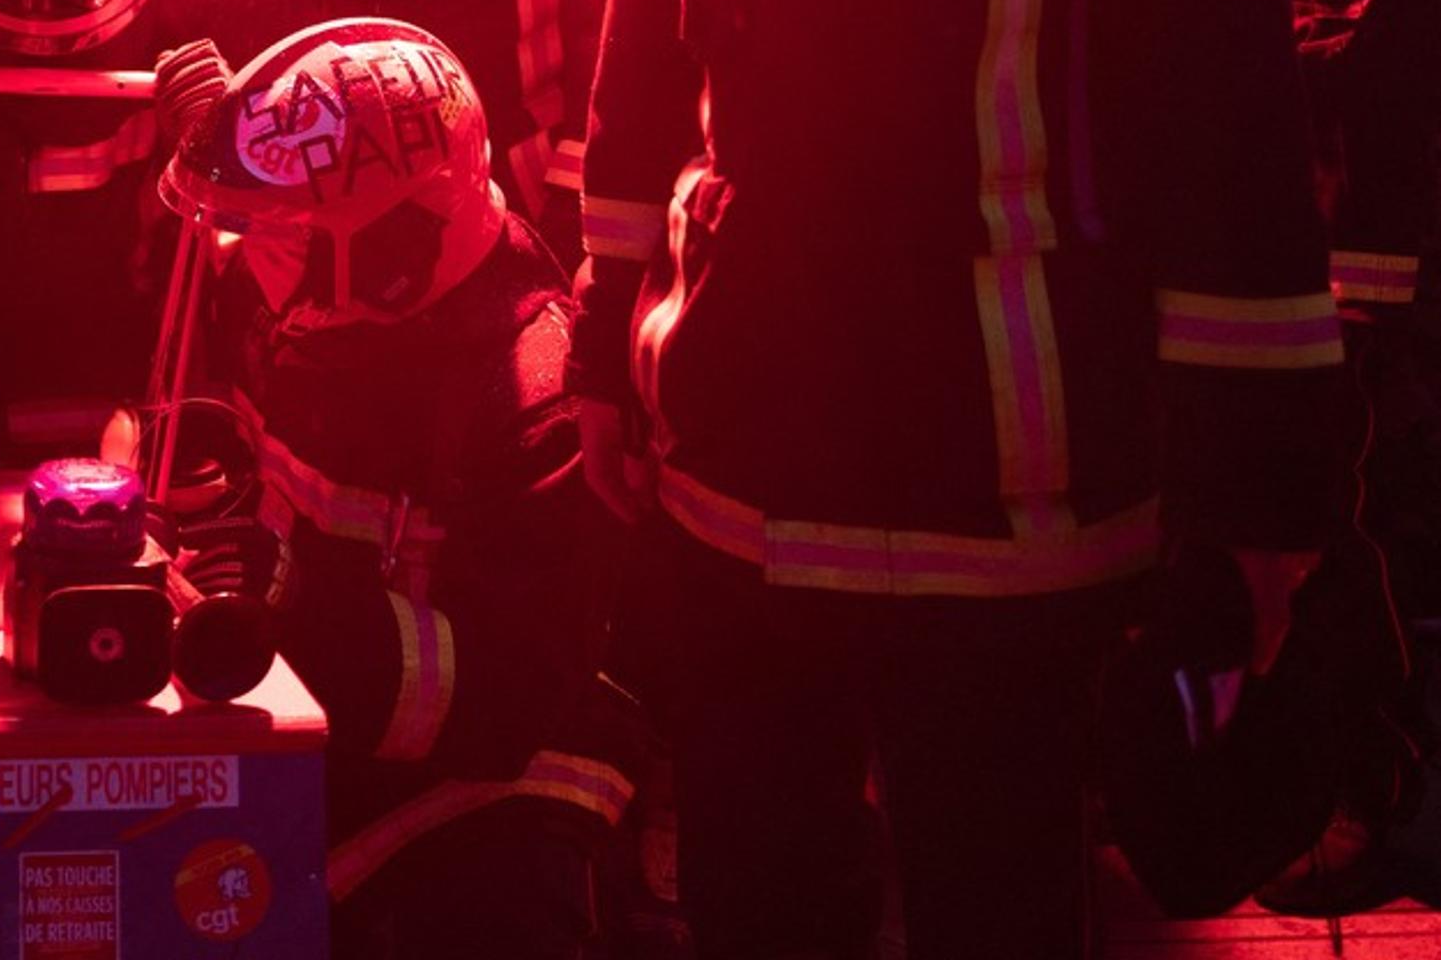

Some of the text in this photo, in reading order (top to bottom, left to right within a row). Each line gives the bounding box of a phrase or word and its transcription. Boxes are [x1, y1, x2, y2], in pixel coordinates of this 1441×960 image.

[248, 140, 301, 177] cgt
[301, 107, 449, 203] PAPI
[85, 759, 228, 804] POMPIERS
[25, 865, 114, 888] PAS TOUCHE
[37, 896, 62, 915] NOS
[65, 895, 114, 914] CAISSES
[196, 903, 240, 934] cgt
[25, 921, 115, 944] DE RETRAITE
